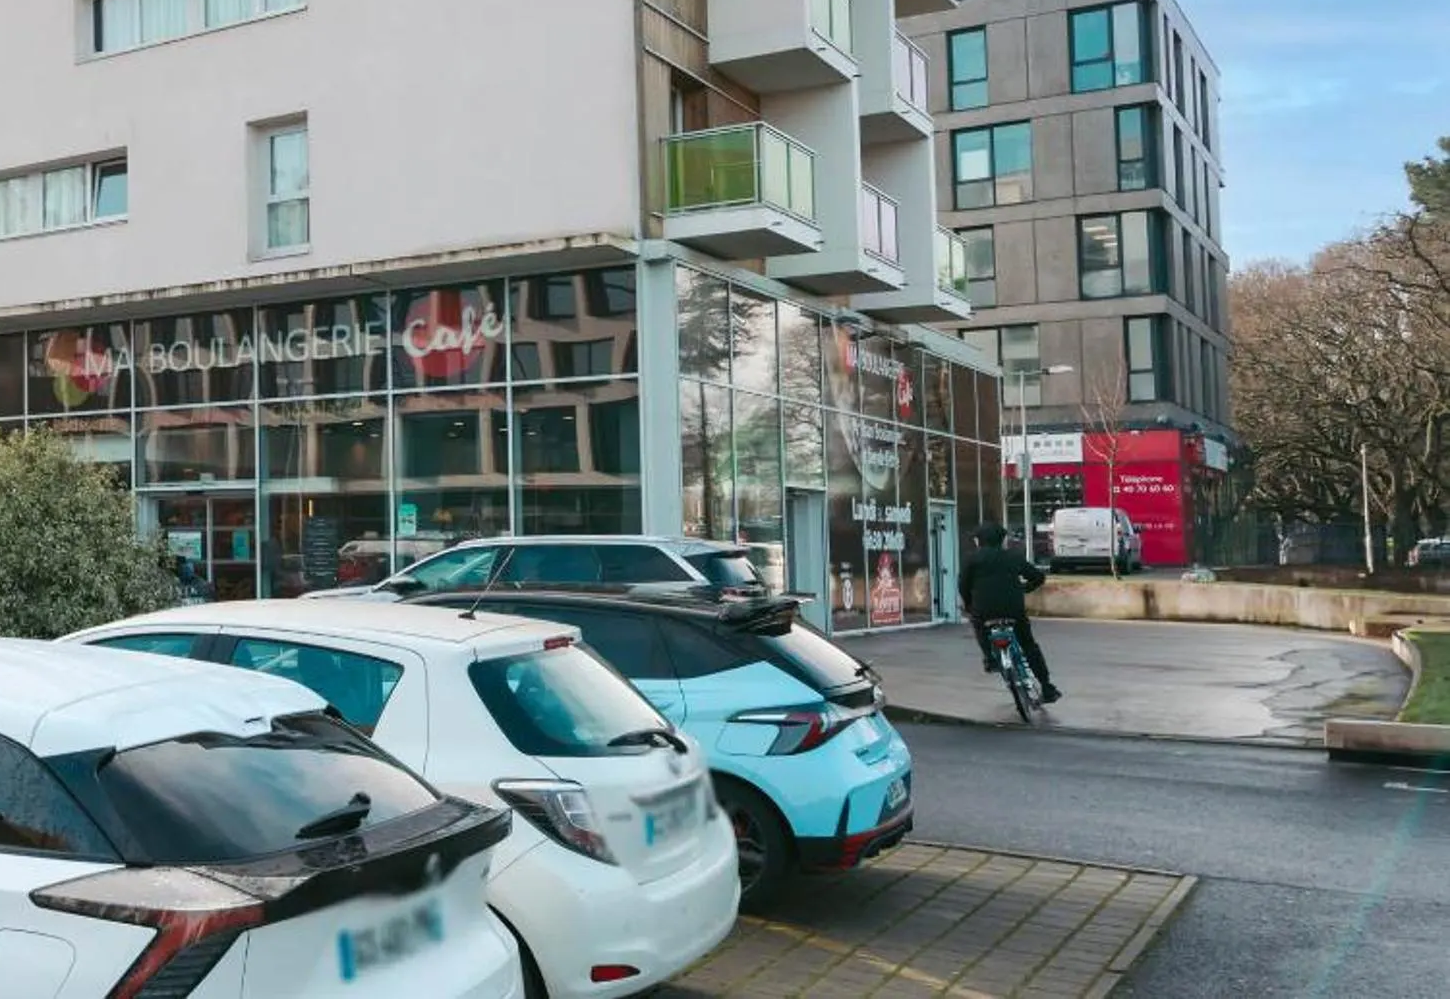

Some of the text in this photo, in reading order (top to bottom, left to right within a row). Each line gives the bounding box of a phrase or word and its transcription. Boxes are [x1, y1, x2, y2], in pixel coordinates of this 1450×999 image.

[84, 303, 506, 378] MA BOULANGERIE Café
